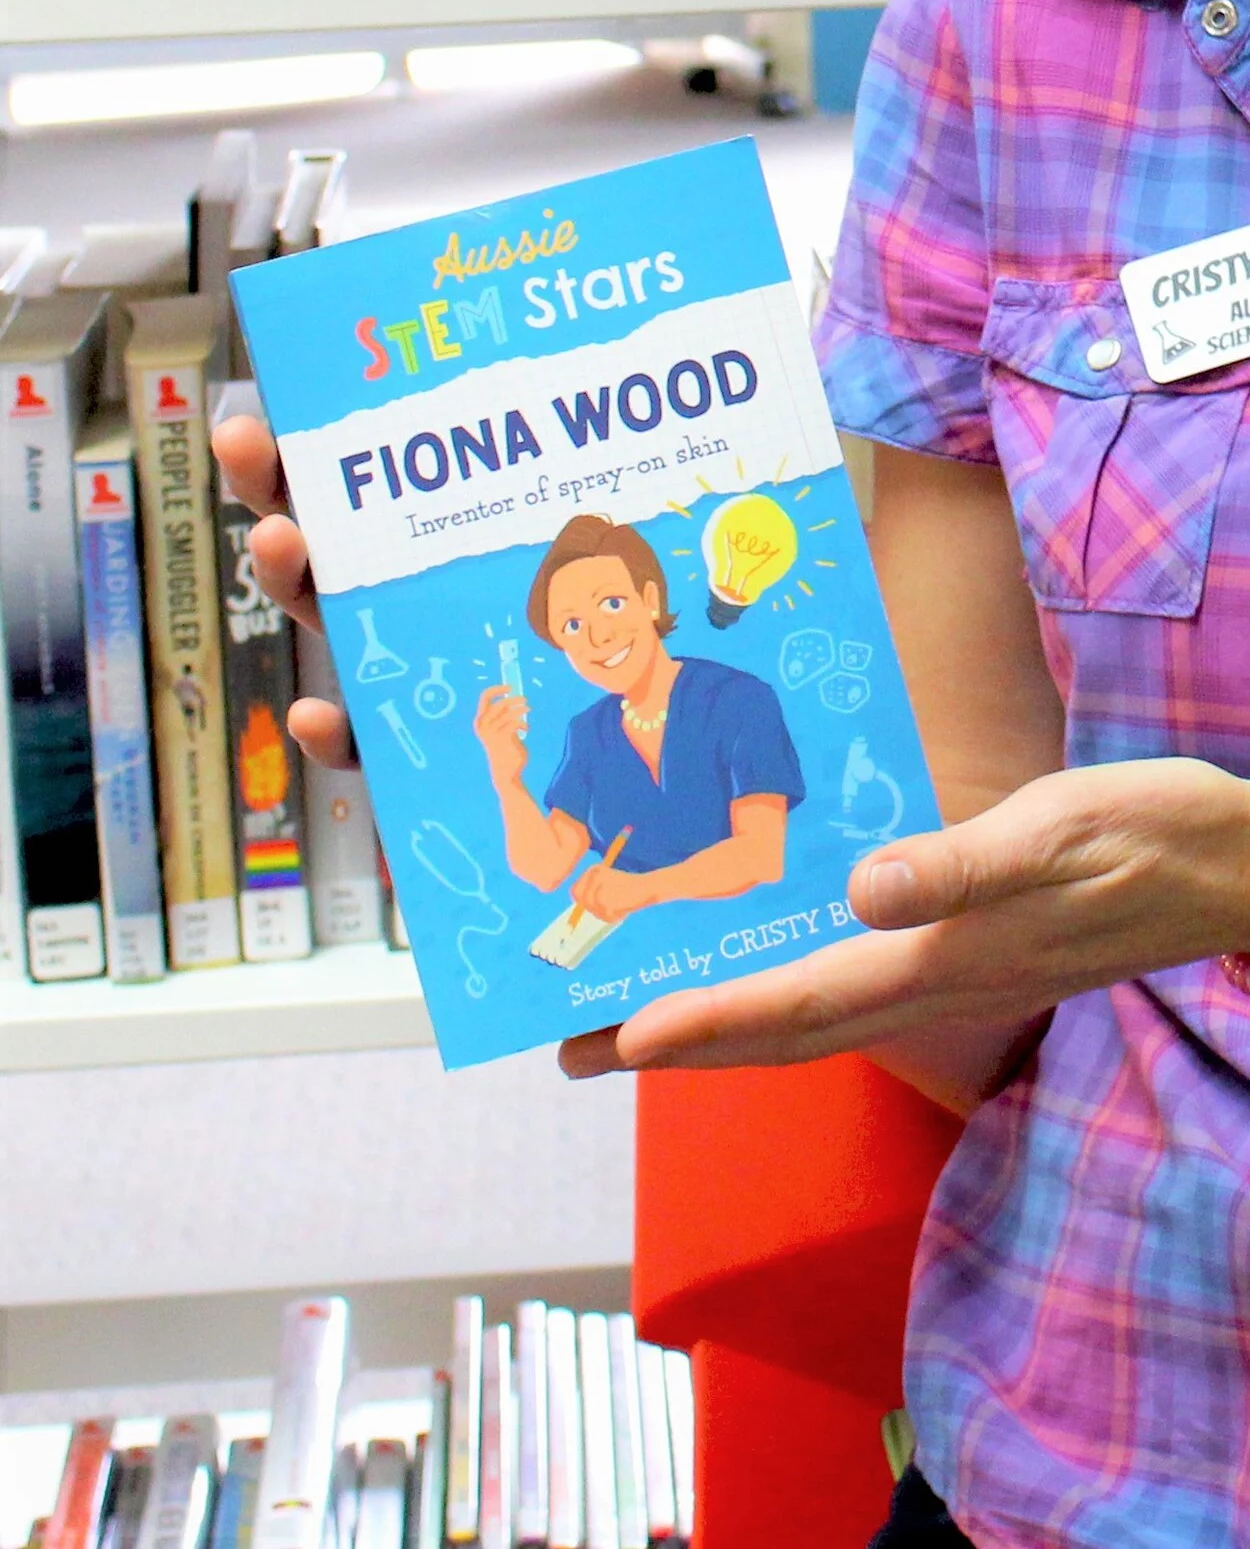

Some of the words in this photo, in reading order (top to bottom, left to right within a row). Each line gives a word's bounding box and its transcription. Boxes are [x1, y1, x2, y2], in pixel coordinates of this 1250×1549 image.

[432, 208, 579, 290] Aussie
[354, 285, 509, 382] STEM
[523, 250, 686, 329] Stars
[159, 421, 194, 513] PEOPLE
[338, 409, 543, 511] FIONA
[551, 349, 759, 450] WOOD
[24, 446, 45, 513] Alone
[405, 493, 516, 539] Inventor
[523, 474, 551, 505] of
[557, 456, 668, 504] spray-on
[676, 435, 731, 466] skin
[164, 522, 202, 653] SMUGGLER
[227, 607, 282, 643] BUS
[567, 976, 632, 1006] Story
[639, 953, 682, 985] told
[687, 948, 714, 976] by
[719, 908, 821, 960] CRISTY
